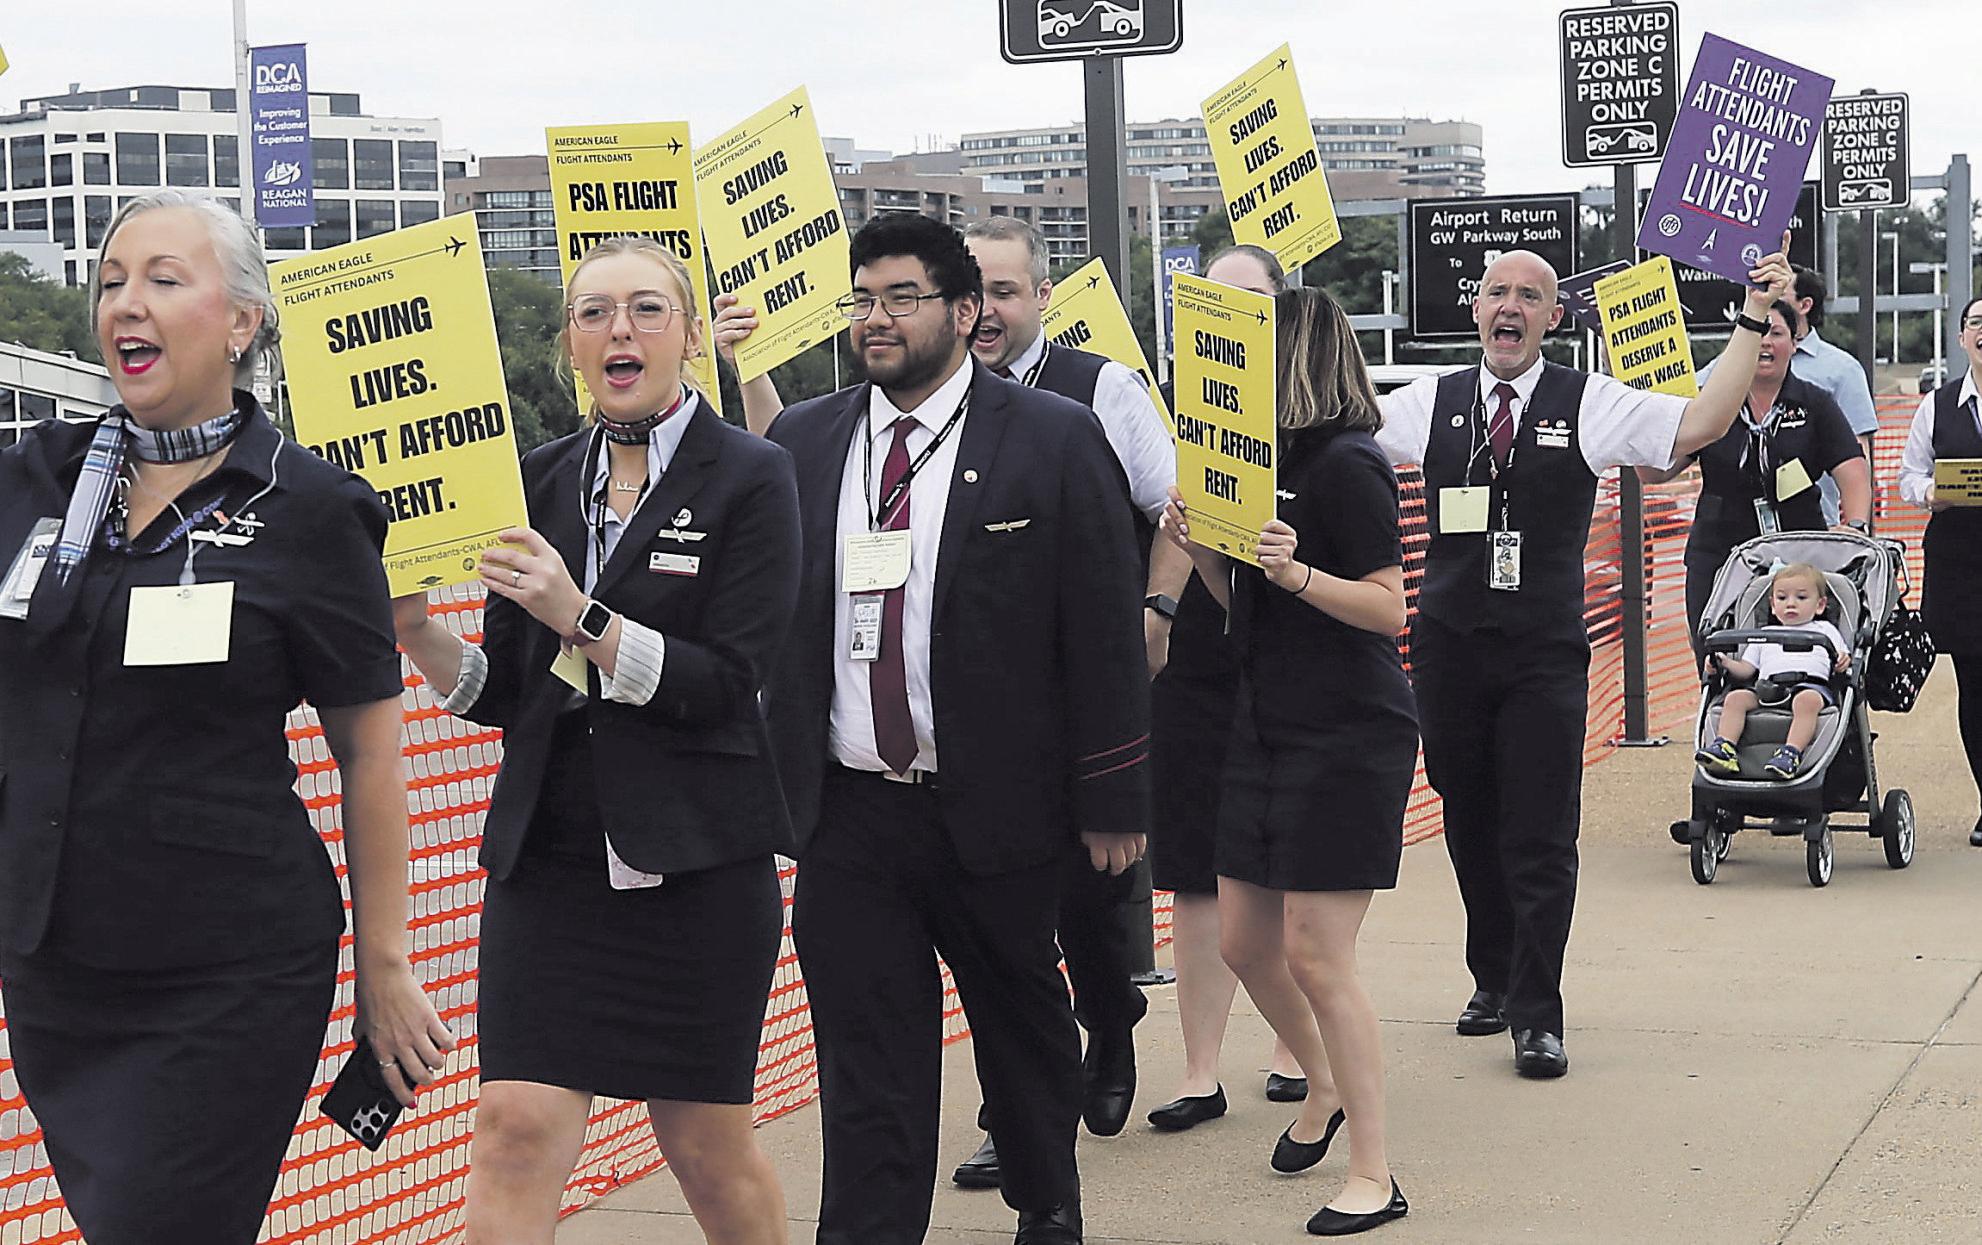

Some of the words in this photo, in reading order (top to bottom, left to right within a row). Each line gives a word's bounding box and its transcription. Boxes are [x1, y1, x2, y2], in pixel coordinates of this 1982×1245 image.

[1566, 12, 1670, 38] RESERVED
[1570, 34, 1667, 59] PARKING
[256, 63, 301, 85] DCA
[1577, 58, 1638, 80] ZONE
[1648, 56, 1662, 74] C
[1727, 57, 1797, 106] FLIGHT
[1577, 78, 1663, 102] PERMITS
[260, 107, 301, 119] Improving
[1229, 98, 1278, 145] SAVING
[1591, 100, 1649, 122] ONLY
[1691, 80, 1811, 147] ATTENDANTS
[1825, 100, 1902, 118] RESERVED
[1828, 115, 1900, 134] PARKING
[254, 122, 266, 132] the
[269, 121, 307, 132] Customer
[258, 135, 304, 146] Experience
[554, 137, 593, 146] AMERICAN
[594, 136, 618, 145] EAGLE
[1833, 132, 1879, 149] ZONE
[1886, 131, 1897, 145] C
[556, 155, 583, 164] FLIGHT
[583, 153, 633, 163] ATTENDANTS
[1244, 135, 1284, 174] LIVES.
[1705, 124, 1775, 181] SAVE
[1832, 147, 1897, 165] PERMITS
[722, 150, 788, 205] SAVING
[1229, 181, 1267, 222] CAN'T
[1269, 149, 1318, 196] AFFORD
[1843, 163, 1887, 179] ONLY
[262, 188, 307, 199] REAGAN
[263, 198, 307, 208] NATIONAL
[568, 182, 609, 212] PSA
[612, 180, 677, 211] FLIGHT
[1682, 163, 1769, 228] LIVES!
[741, 194, 795, 239] LIVES.
[1262, 201, 1301, 239] RENT.
[1430, 211, 1490, 229] Airport
[1501, 209, 1557, 223] Return
[720, 248, 770, 294] CAN'T
[774, 209, 840, 265] AFFORD
[1430, 232, 1456, 245] GW
[1463, 230, 1519, 244] Parkway
[1523, 227, 1561, 241] South
[281, 262, 336, 285] AMERICAN
[338, 252, 374, 270] EAGLE
[1165, 257, 1195, 271] DCA
[1449, 258, 1462, 268] To
[284, 288, 321, 306] FLIGHT
[324, 269, 395, 297] ATTENDANTS
[763, 271, 815, 315] RENT.
[1608, 304, 1631, 322] PSA
[1631, 286, 1667, 313] FLIGHT
[325, 296, 433, 354] SAVING
[1611, 310, 1676, 348] ATTENDANTS
[1195, 330, 1246, 370] SAVING
[1621, 342, 1666, 370] DESERVE
[1669, 337, 1677, 352] A
[350, 359, 438, 409] LIVES.
[1653, 360, 1690, 384] WAGE.
[1202, 377, 1243, 415] LIVES.
[399, 402, 506, 460] AFFORD
[1177, 413, 1216, 450] CAN'T
[1220, 428, 1272, 469] AFFORD
[1204, 466, 1242, 505] RENT.
[390, 556, 413, 571] Flight
